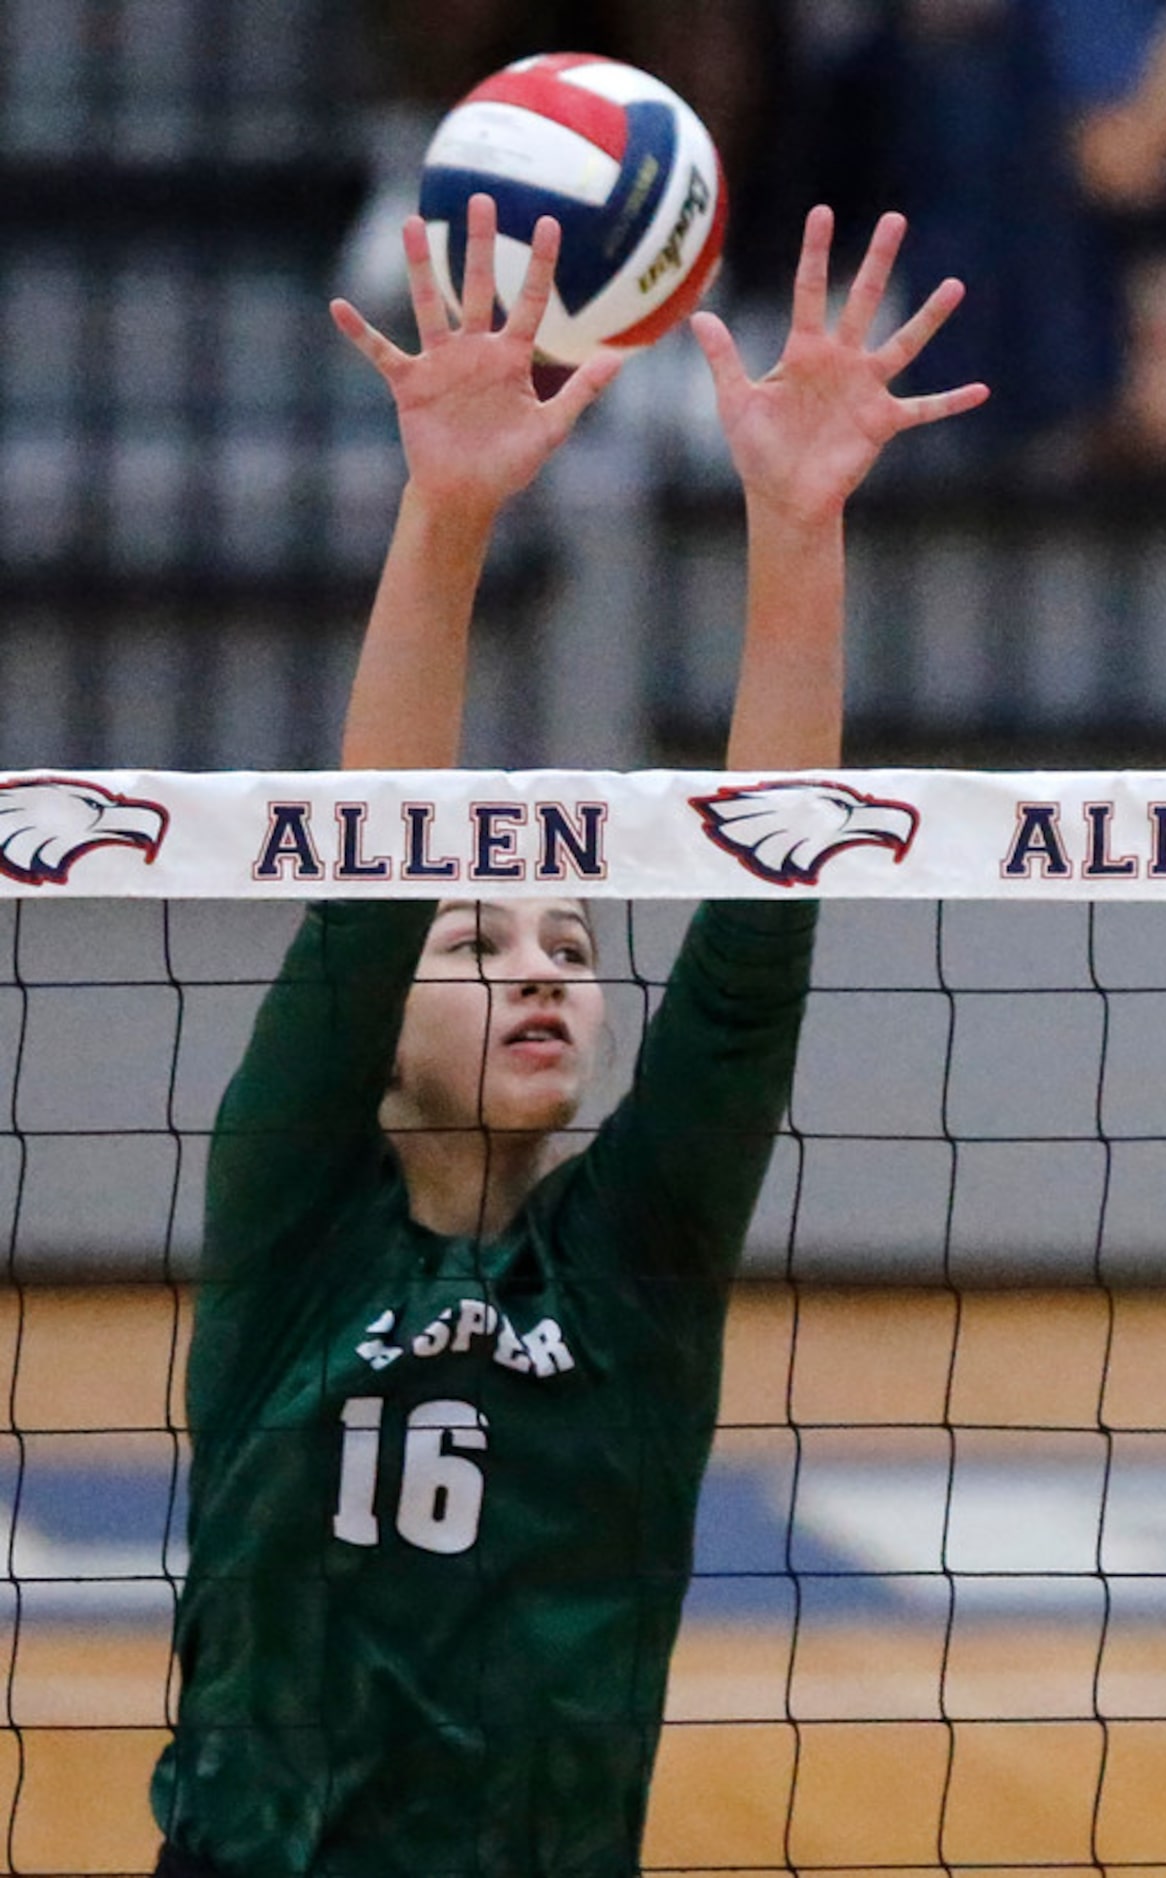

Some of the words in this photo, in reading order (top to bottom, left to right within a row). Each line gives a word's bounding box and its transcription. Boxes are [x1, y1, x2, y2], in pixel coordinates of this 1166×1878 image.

[252, 801, 608, 881] ALLEN
[355, 1299, 575, 1377] SPER
[333, 1396, 489, 1554] 16
